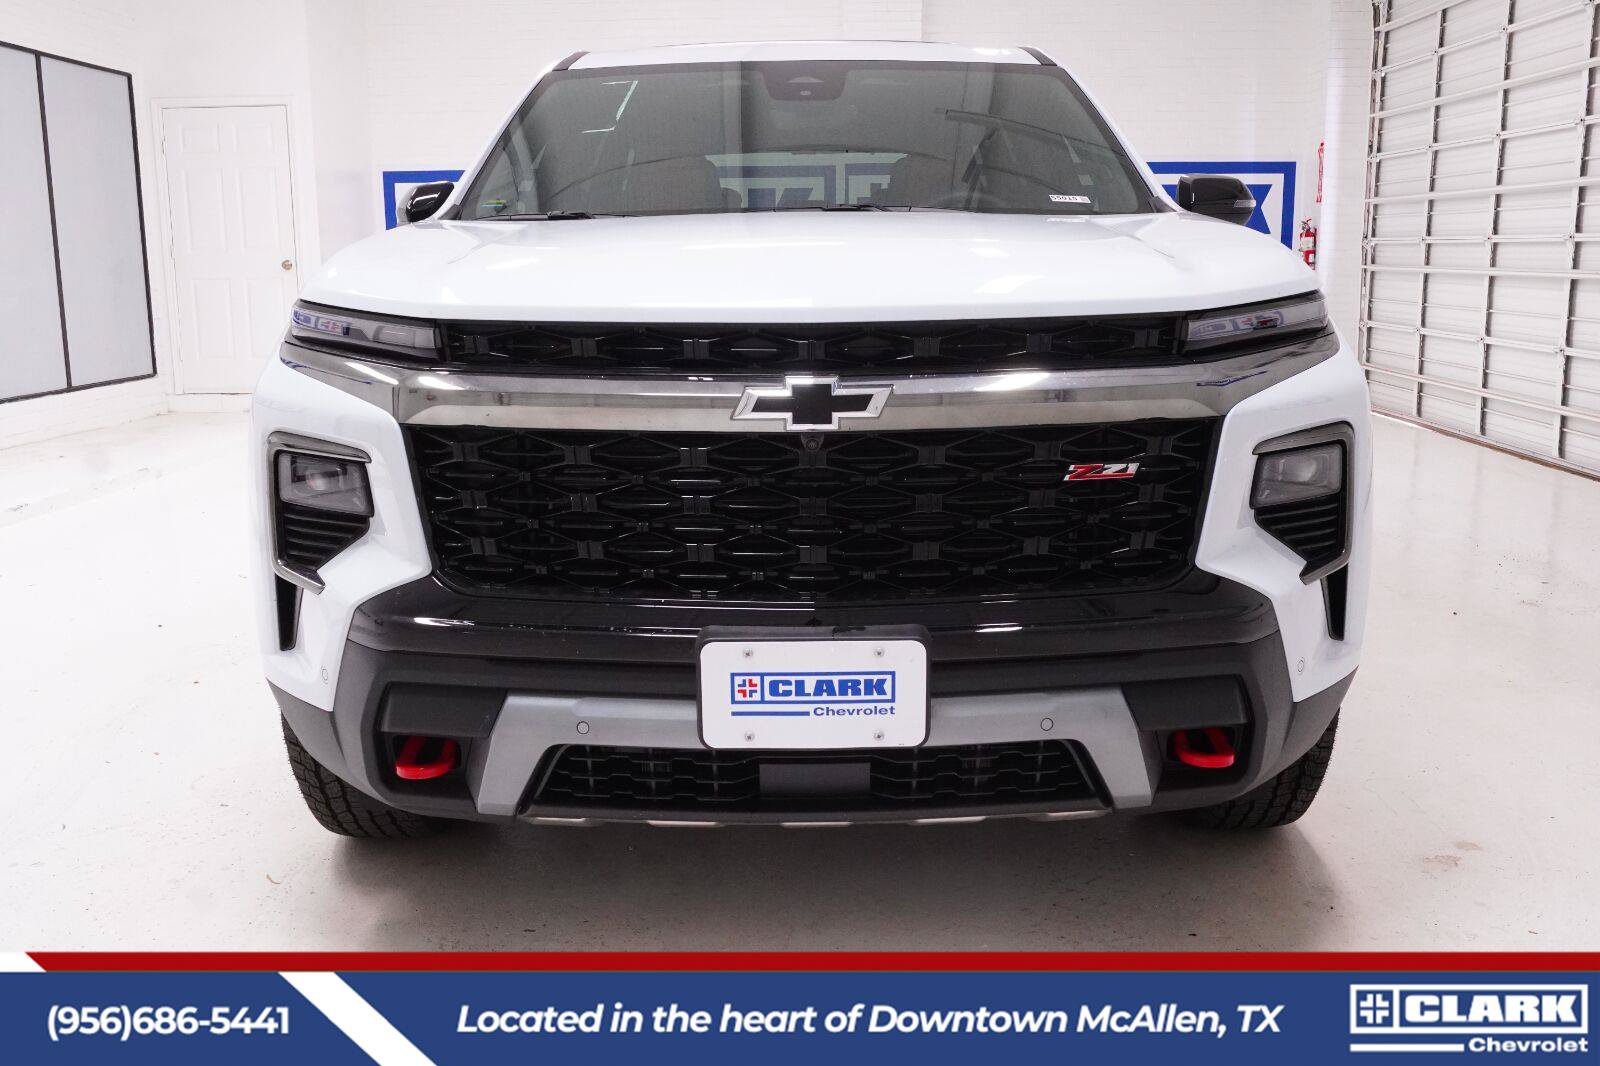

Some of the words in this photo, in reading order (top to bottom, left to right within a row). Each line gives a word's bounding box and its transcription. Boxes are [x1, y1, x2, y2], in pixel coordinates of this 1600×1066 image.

[1064, 463, 1139, 481] Z71
[768, 678, 888, 698] CLARK
[813, 705, 896, 717] Chevrolet
